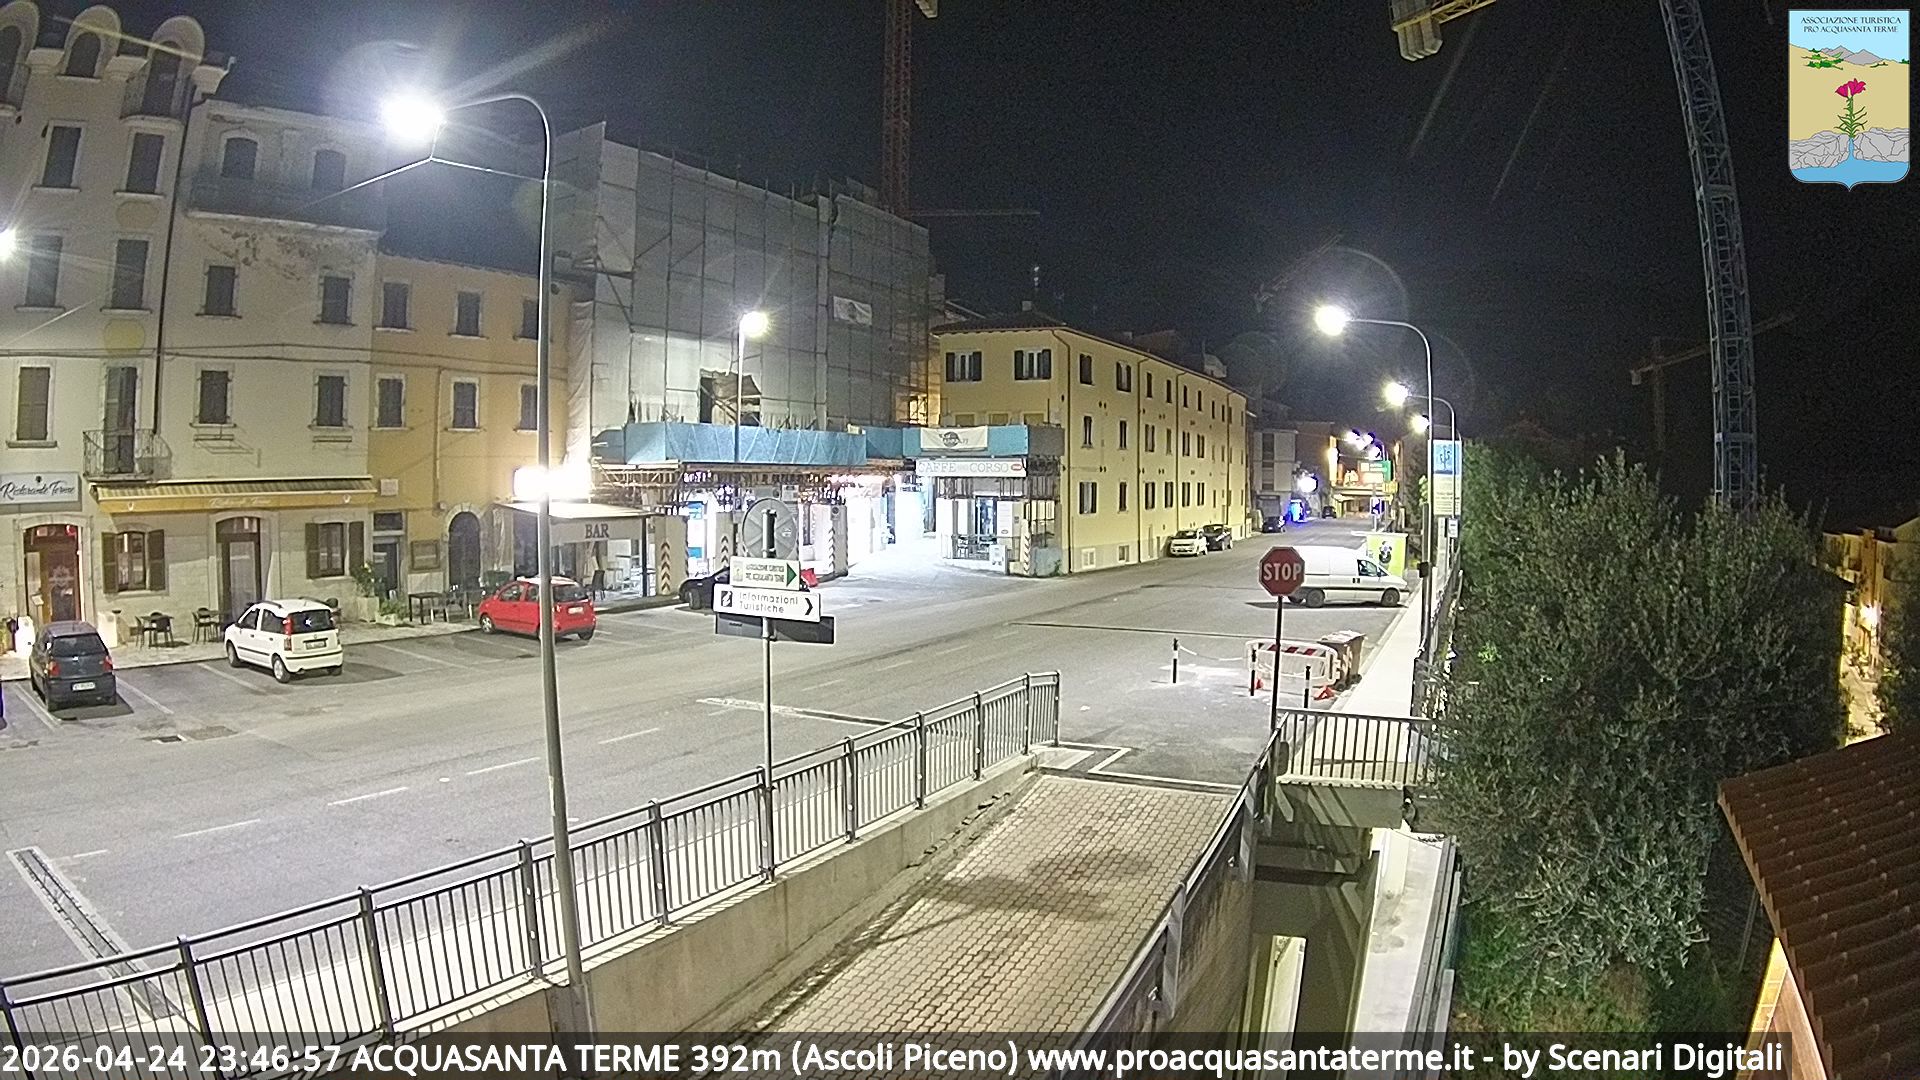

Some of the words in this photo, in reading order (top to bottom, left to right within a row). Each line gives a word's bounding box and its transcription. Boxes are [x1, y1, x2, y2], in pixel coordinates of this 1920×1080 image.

[969, 462, 1009, 473] CORSO
[585, 523, 609, 539] BAR
[1263, 562, 1302, 581] STOP
[739, 591, 798, 605] Informazioni
[739, 600, 784, 614] Turistiche
